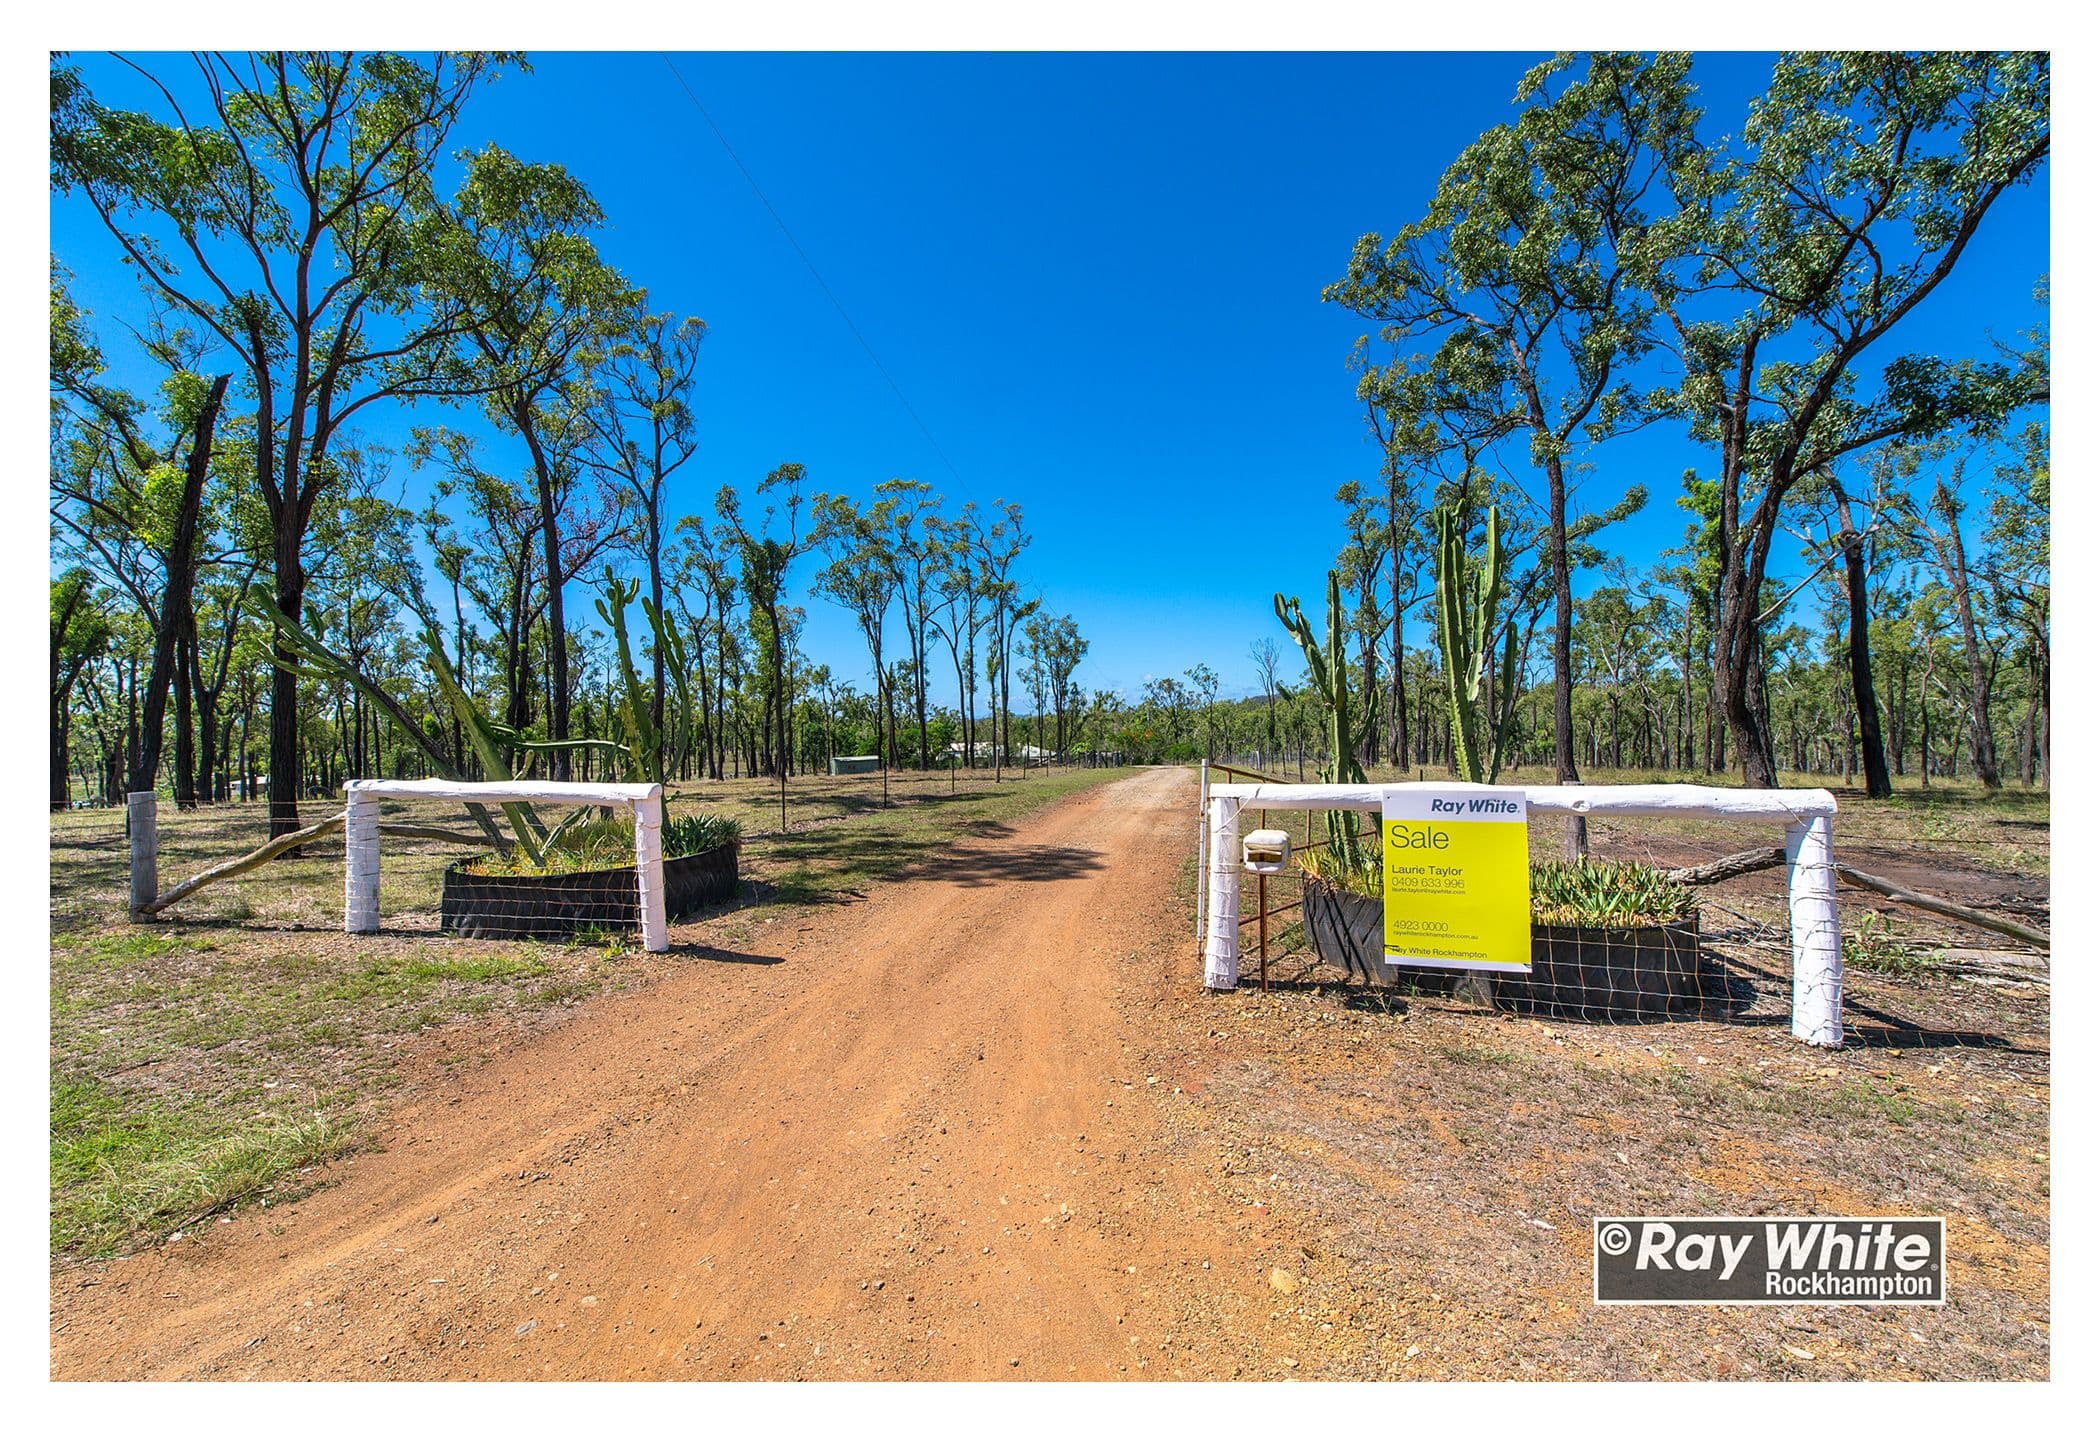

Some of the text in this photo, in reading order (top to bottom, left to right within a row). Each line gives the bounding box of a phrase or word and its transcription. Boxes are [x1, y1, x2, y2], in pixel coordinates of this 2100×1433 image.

[1431, 798, 1518, 815] Ray White
[1391, 825, 1449, 849] Sale
[1392, 864, 1463, 877] Laurie Taylor
[1391, 876, 1418, 887] 0409
[1421, 877, 1441, 888] 633
[1393, 920, 1448, 932] 4923 0000
[1409, 947, 1431, 955] White
[1433, 948, 1487, 959] Rockhampton
